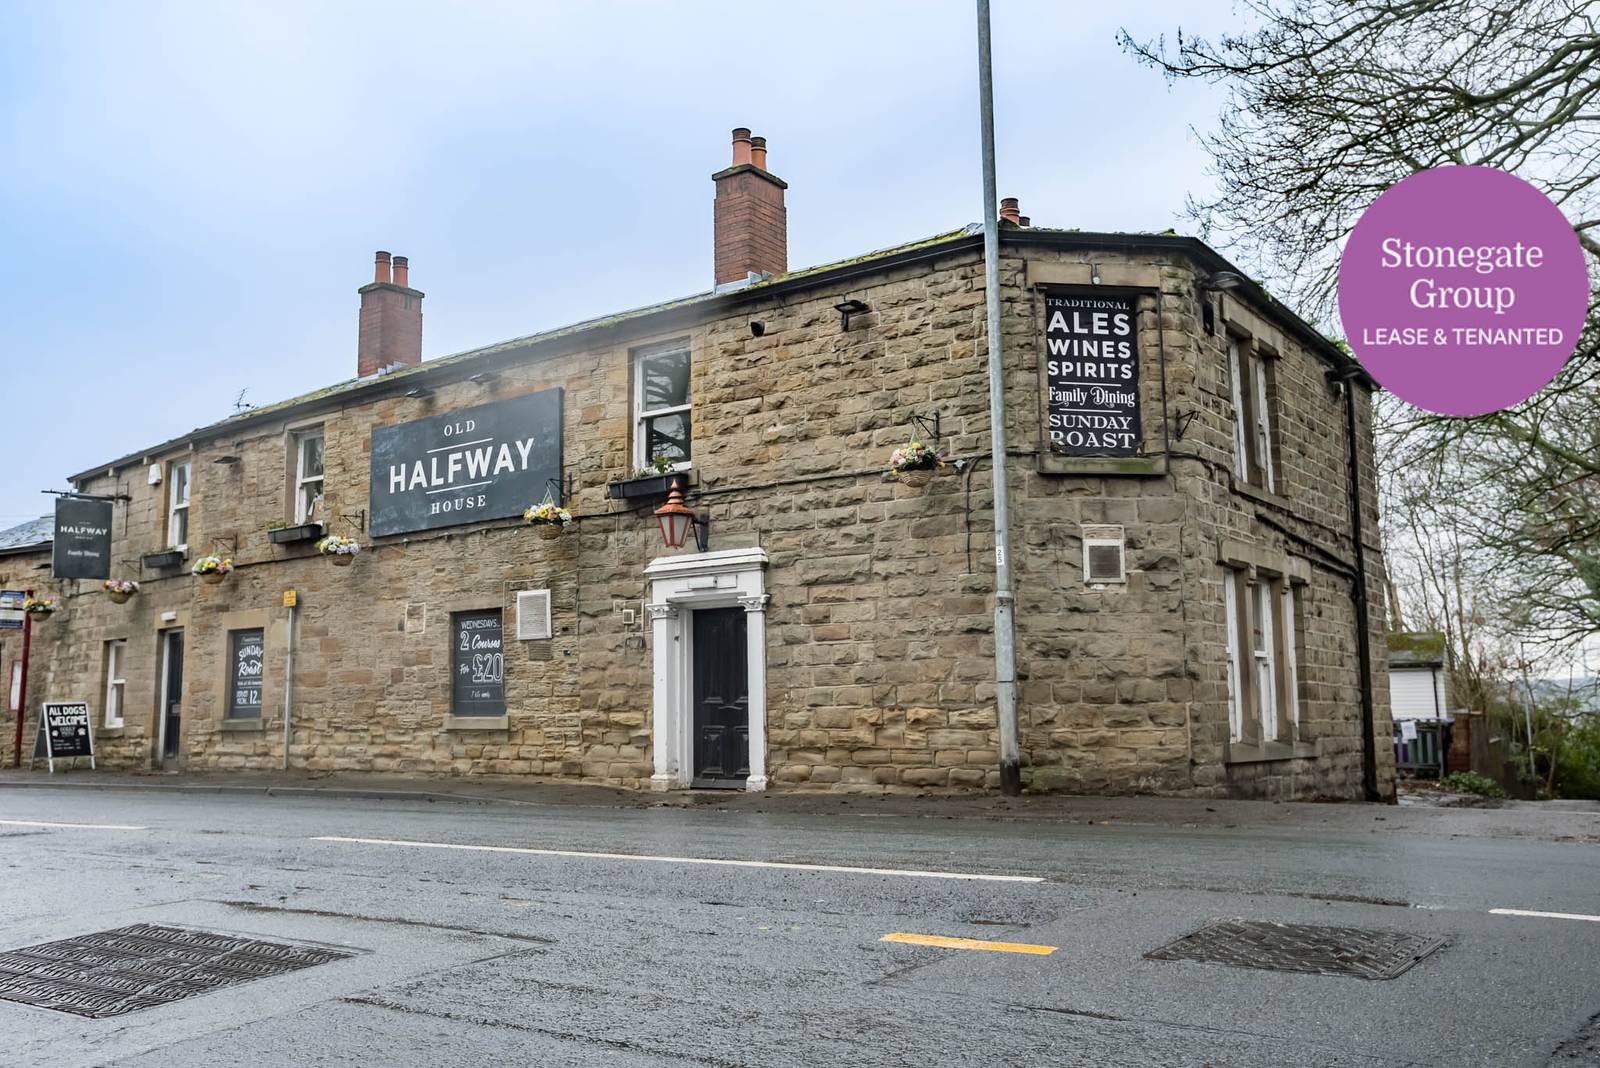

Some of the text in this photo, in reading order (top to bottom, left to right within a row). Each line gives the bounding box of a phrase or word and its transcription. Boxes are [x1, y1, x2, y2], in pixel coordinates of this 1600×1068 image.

[1046, 298, 1130, 310] TRADITIONAL
[1047, 310, 1130, 336] ALES
[1047, 338, 1131, 359] WINES
[1047, 360, 1132, 379] SPIRITS
[1048, 386, 1136, 408] Family Dining
[443, 420, 475, 437] OLD
[1049, 413, 1133, 430] SUNDAY
[1049, 430, 1136, 449] ROAST
[389, 437, 535, 494] HALFWAY
[431, 494, 487, 515] HOUSE
[60, 525, 108, 536] HALFWAY
[460, 630, 501, 651] 2 Courses
[238, 644, 264, 661] SUNDAY
[238, 659, 262, 677] Roast
[472, 653, 503, 683] £20
[49, 705, 86, 716] ALL DOGS
[49, 715, 87, 726] WELCOME
